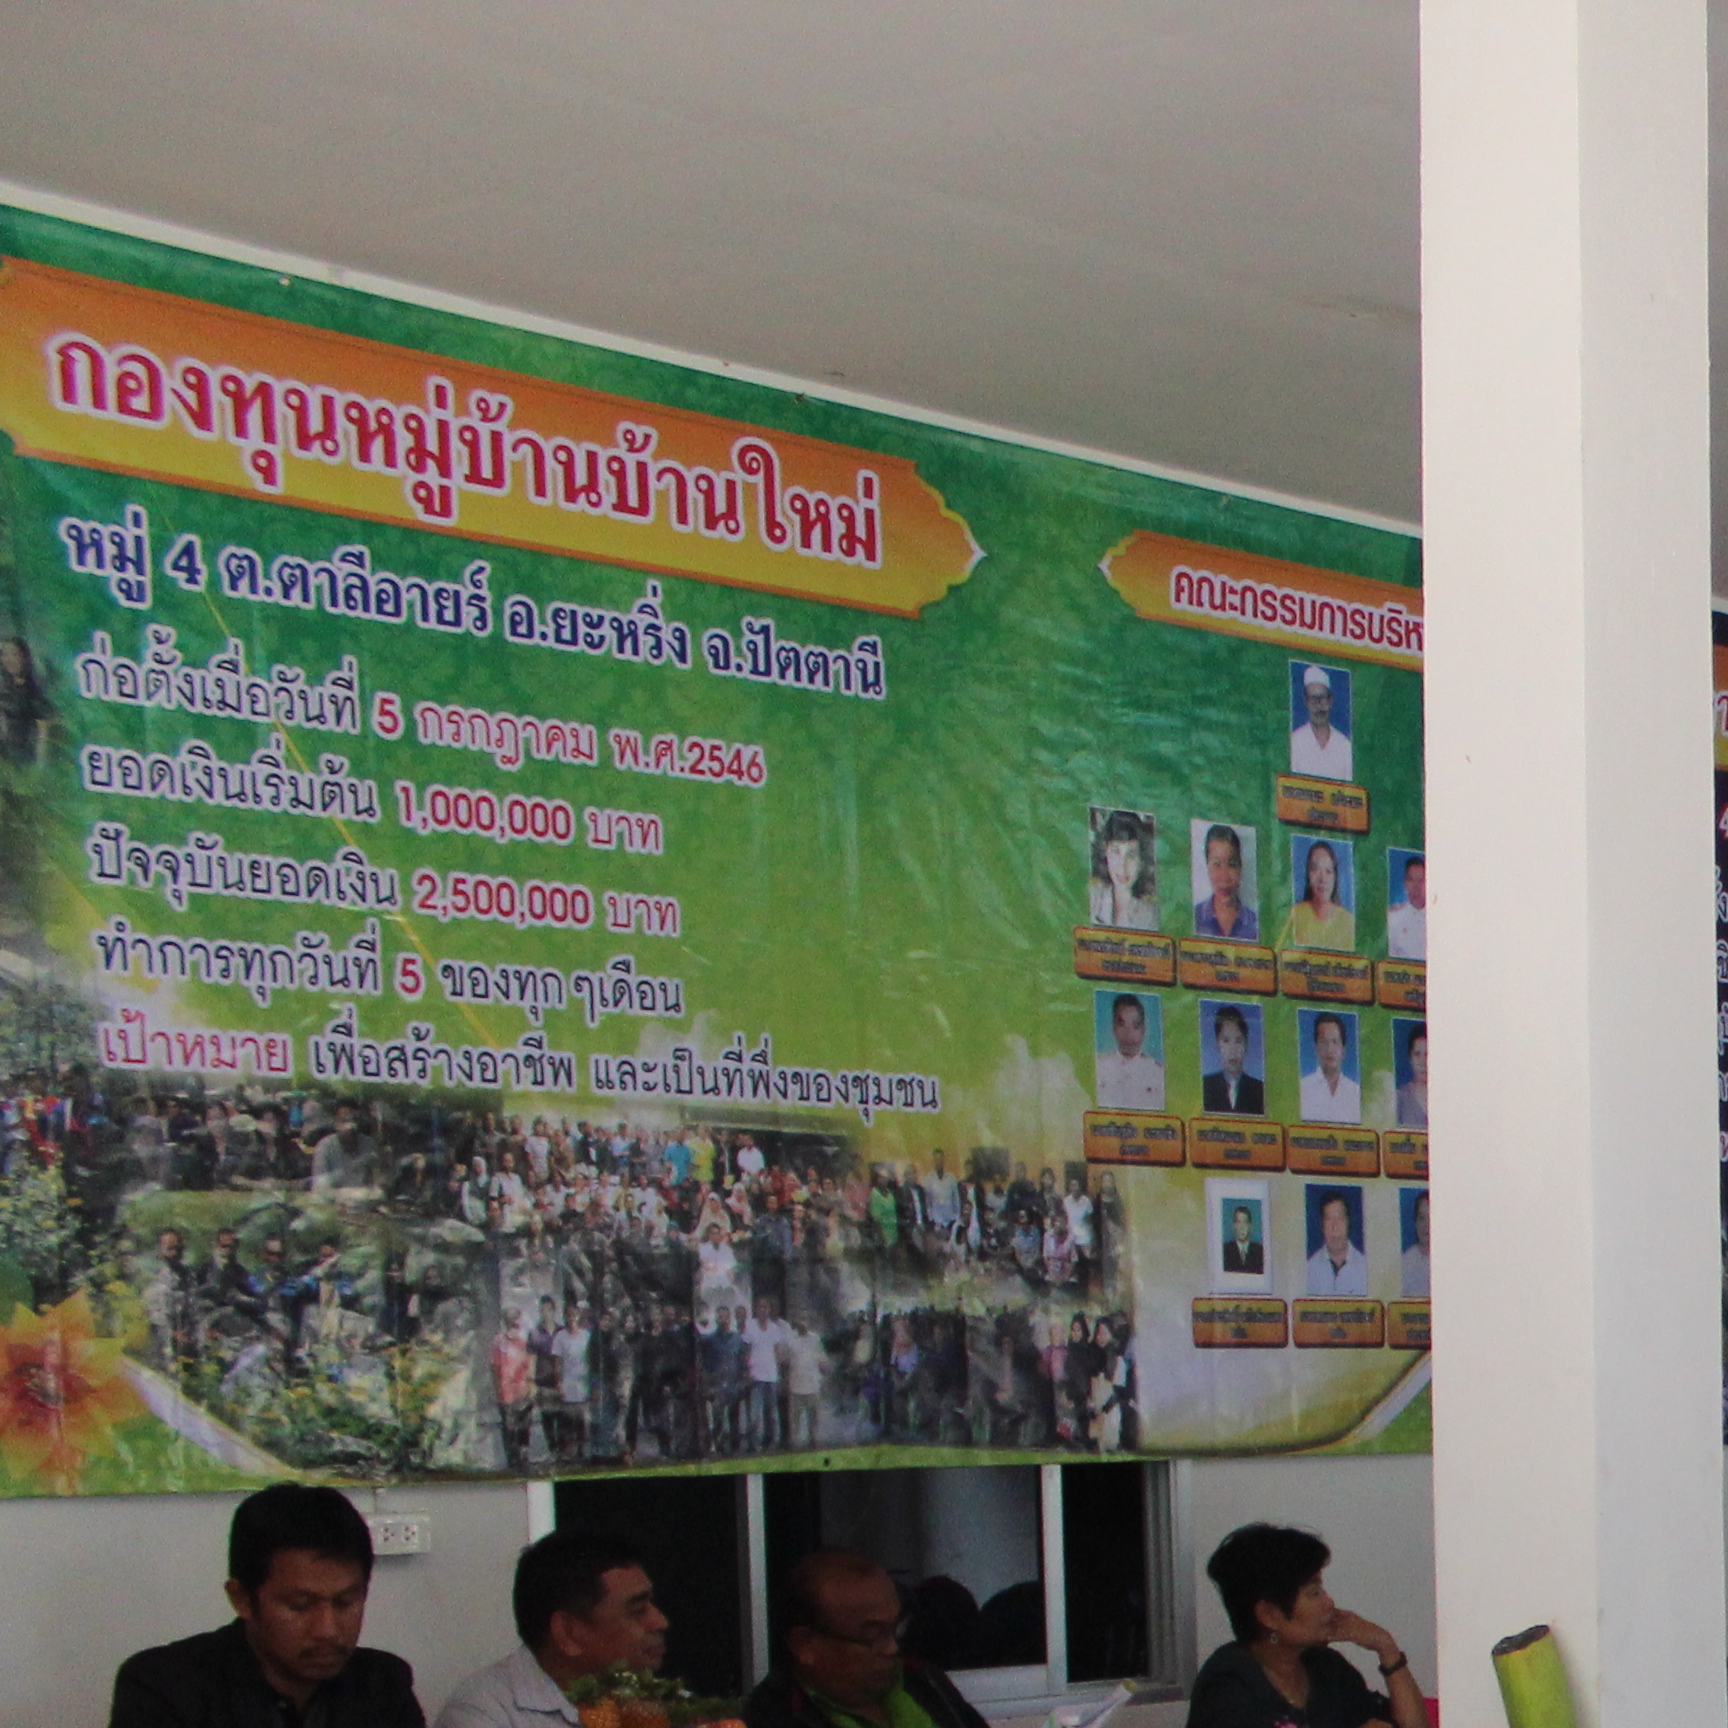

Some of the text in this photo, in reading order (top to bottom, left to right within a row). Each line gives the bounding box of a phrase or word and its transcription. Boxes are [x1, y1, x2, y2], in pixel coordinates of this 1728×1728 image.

[53, 335, 881, 565] กองทุนหมู่บ้านบ้านใหม่
[61, 508, 886, 698] หมู่ 4 ต.ตาลีอายร์ อ.ยะหริ่ง จ.ปัตตานี
[80, 627, 359, 733] ก่อตั้งเมื่อวันที่
[376, 695, 401, 736] 5
[612, 730, 766, 787] พ.ศ.2546
[86, 736, 663, 853] ยอดเงินเริ่มต้น 1,000,000 บาท
[90, 826, 680, 935] ปัจจุบันยอดเงิน 2,500,000 บาท
[95, 919, 381, 1005] ทำการทุกวันที่
[397, 956, 422, 995] 5
[101, 1005, 940, 1126] เป้าหมาย เพื่อสร้างอาชีพ และเป็นที่พึ่งของชุมชน
